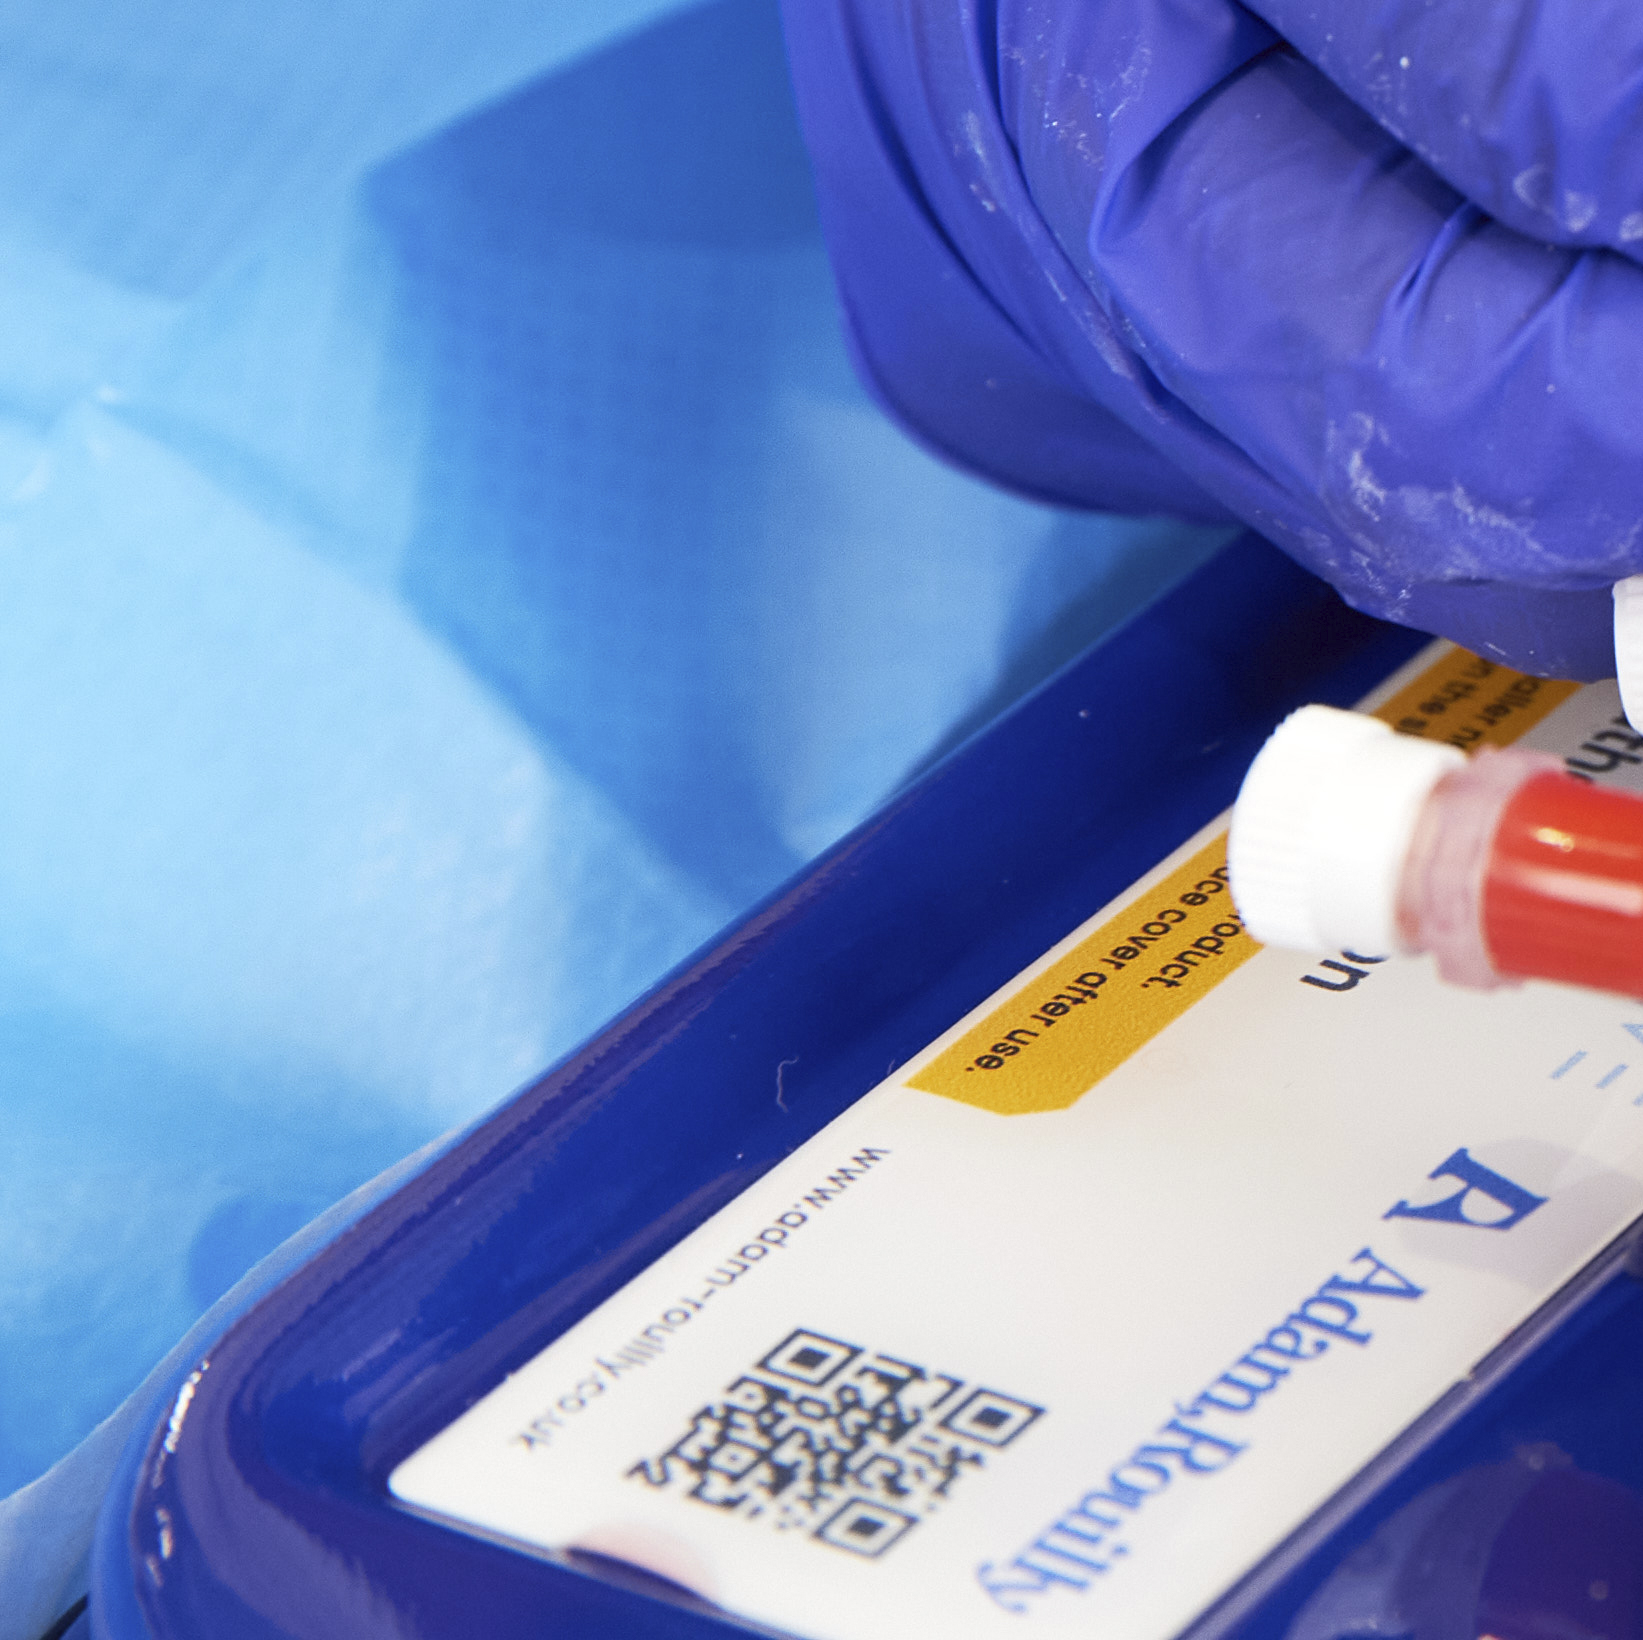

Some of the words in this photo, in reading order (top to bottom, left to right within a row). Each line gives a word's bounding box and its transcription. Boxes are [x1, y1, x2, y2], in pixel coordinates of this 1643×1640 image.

[1101, 907, 1188, 973] cover
[1030, 969, 1109, 1029] after
[965, 1025, 1040, 1073] use.
[509, 1146, 893, 1453] www.adam-rouilly.co.uk
